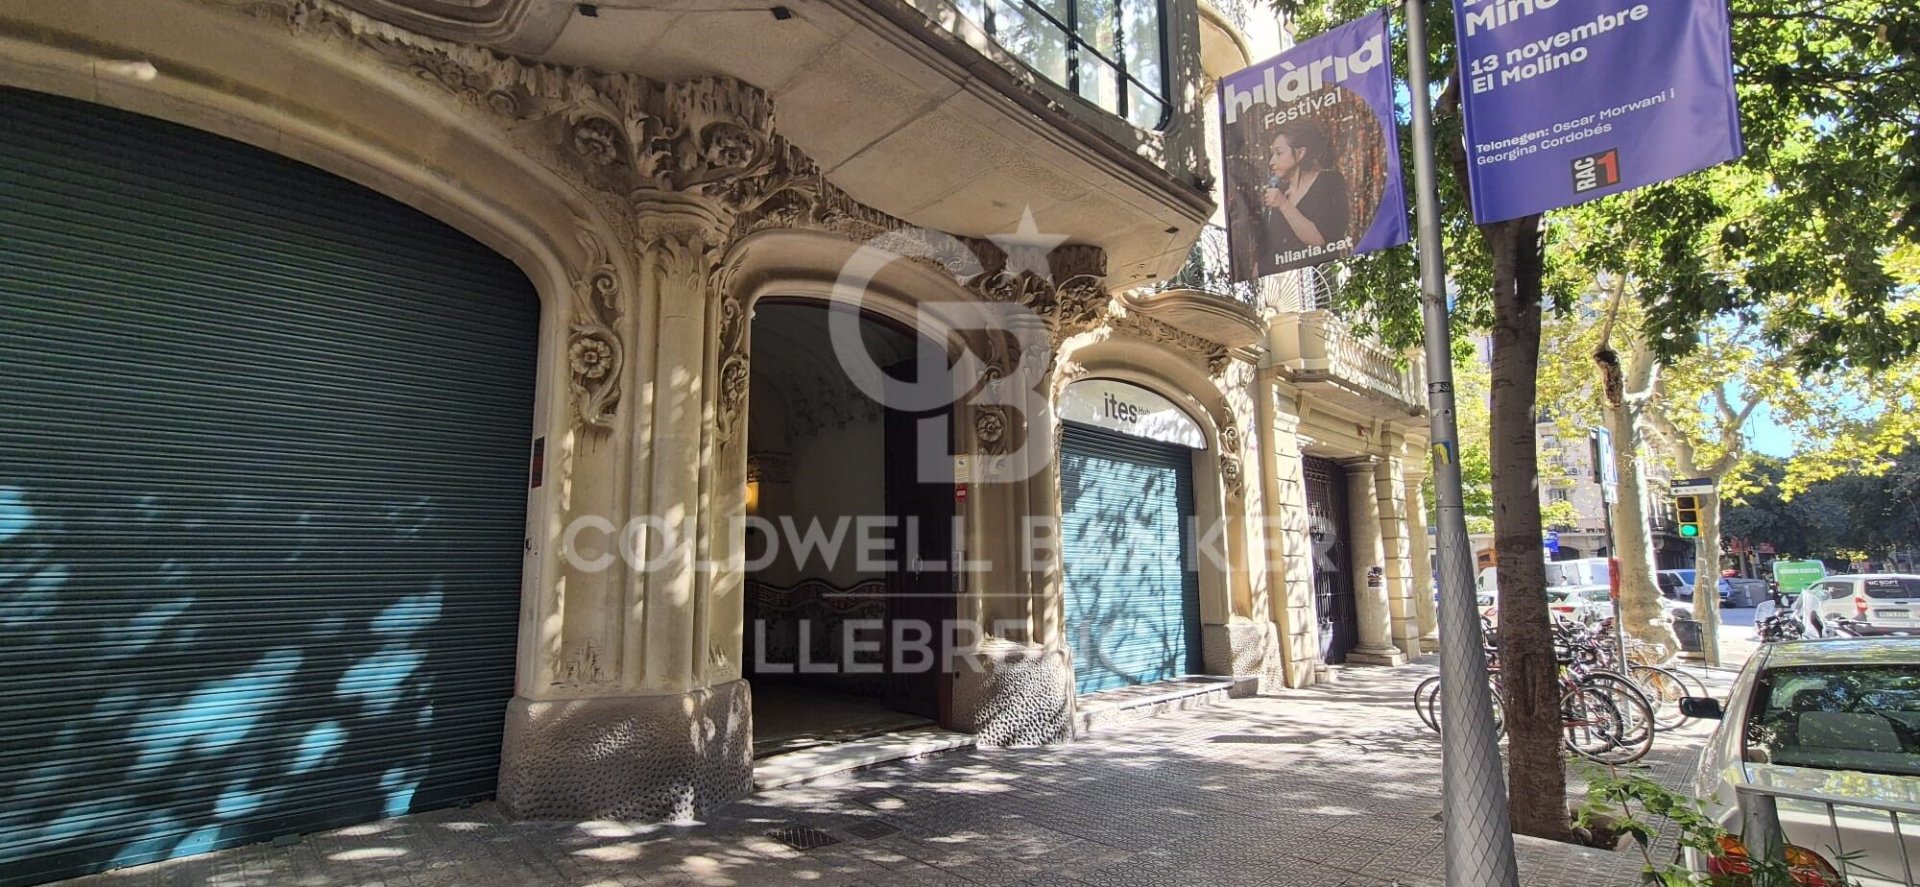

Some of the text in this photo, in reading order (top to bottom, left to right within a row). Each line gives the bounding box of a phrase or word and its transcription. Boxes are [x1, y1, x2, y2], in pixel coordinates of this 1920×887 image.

[1471, 3, 1649, 76] 13 novembre
[1472, 46, 1589, 94] El Molino
[1264, 86, 1342, 130] Festival
[1475, 126, 1550, 154] Telonegen:
[1552, 113, 1596, 133] Oscar
[1599, 90, 1666, 121] Morwani
[1477, 121, 1613, 166] Georgina Cordobés
[1275, 236, 1353, 265] hilaria.cat
[1104, 391, 1138, 424] ites
